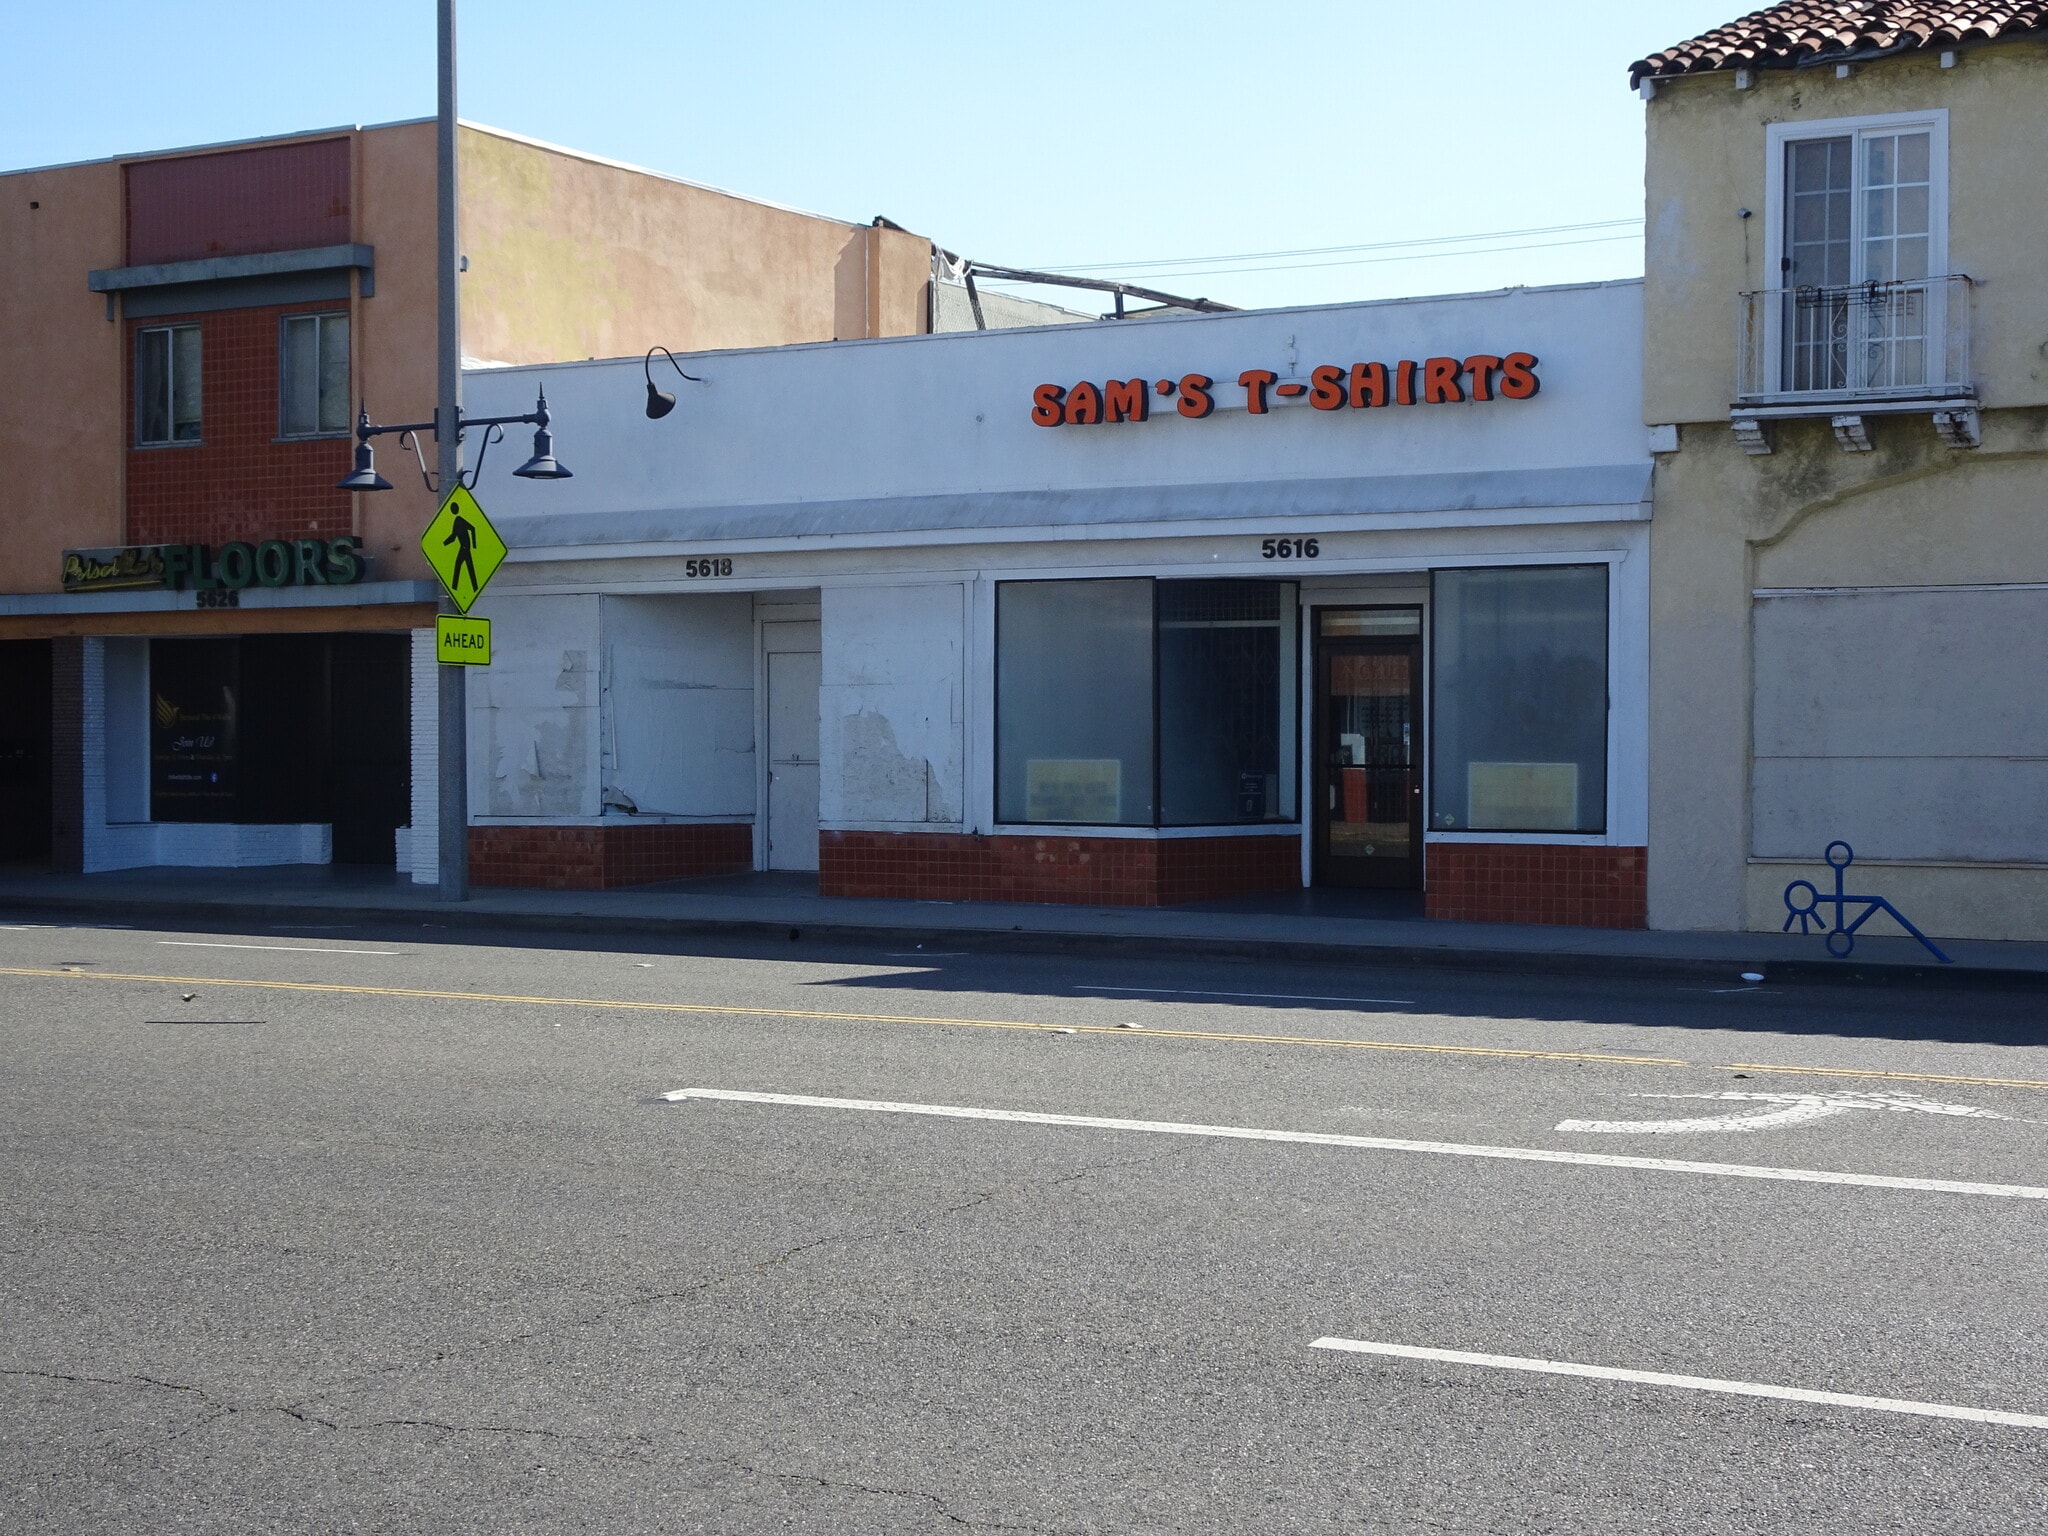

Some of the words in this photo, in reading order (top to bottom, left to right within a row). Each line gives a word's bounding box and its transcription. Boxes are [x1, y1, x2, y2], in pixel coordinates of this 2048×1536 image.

[1031, 372, 1215, 428] SAM'S
[1238, 351, 1541, 415] T-SHIRTS
[1262, 538, 1319, 558] 5616
[162, 535, 366, 591] FLOORS
[686, 558, 732, 578] 5618
[196, 590, 240, 608] 5626
[444, 632, 484, 649] AHEAD
